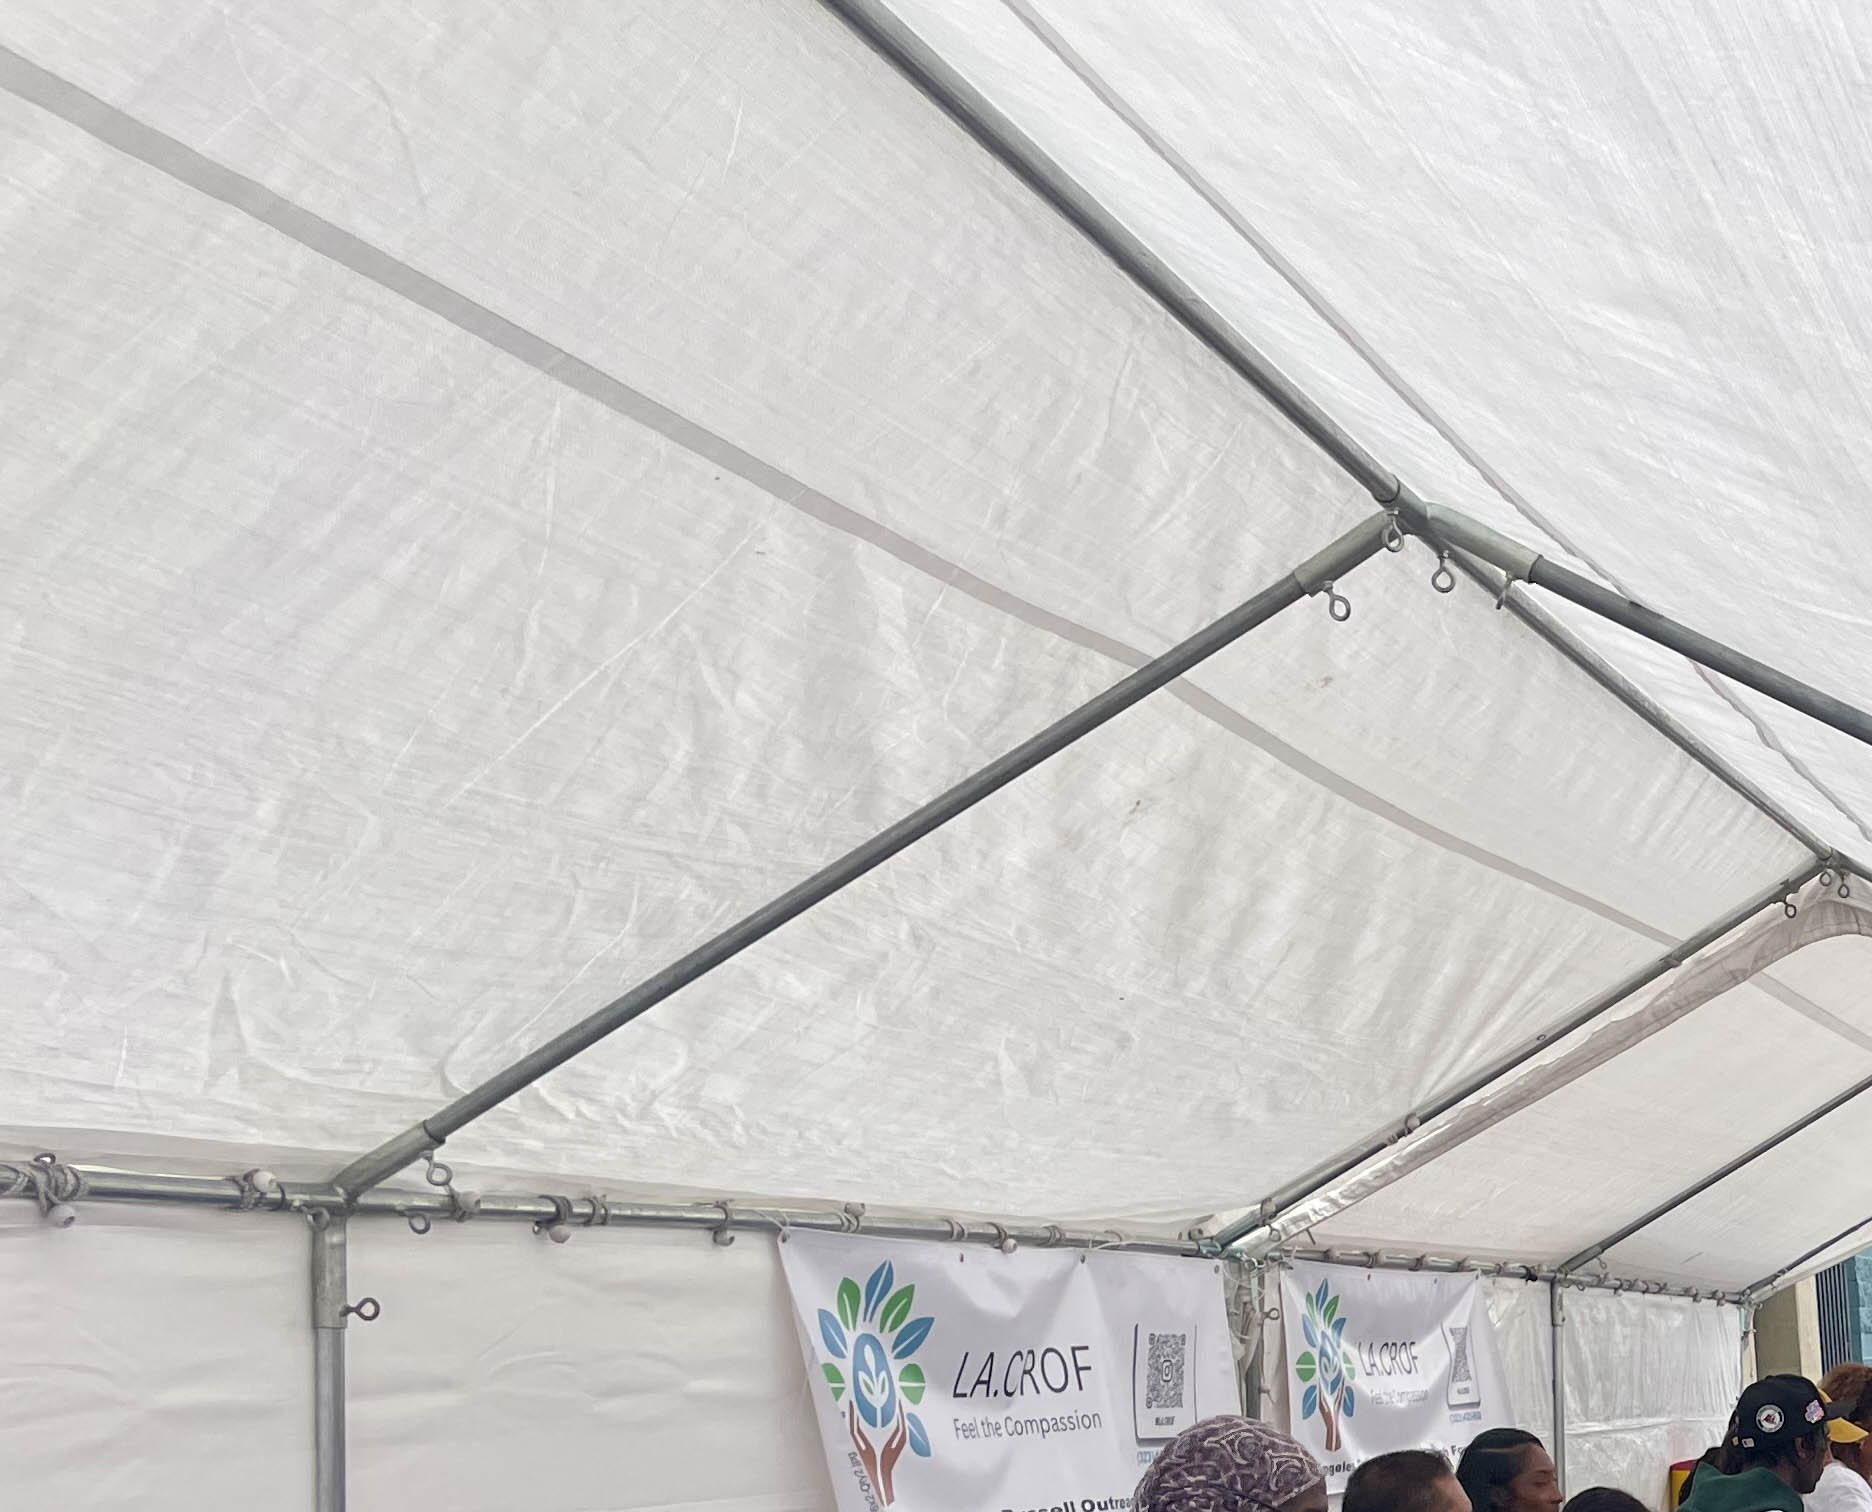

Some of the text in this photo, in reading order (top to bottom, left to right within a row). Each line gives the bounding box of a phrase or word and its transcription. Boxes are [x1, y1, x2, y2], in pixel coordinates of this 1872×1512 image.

[952, 1345, 1092, 1398] LA.CROF
[1358, 1341, 1418, 1376] LA.CROF
[953, 1409, 1102, 1440] Feel the Compassion
